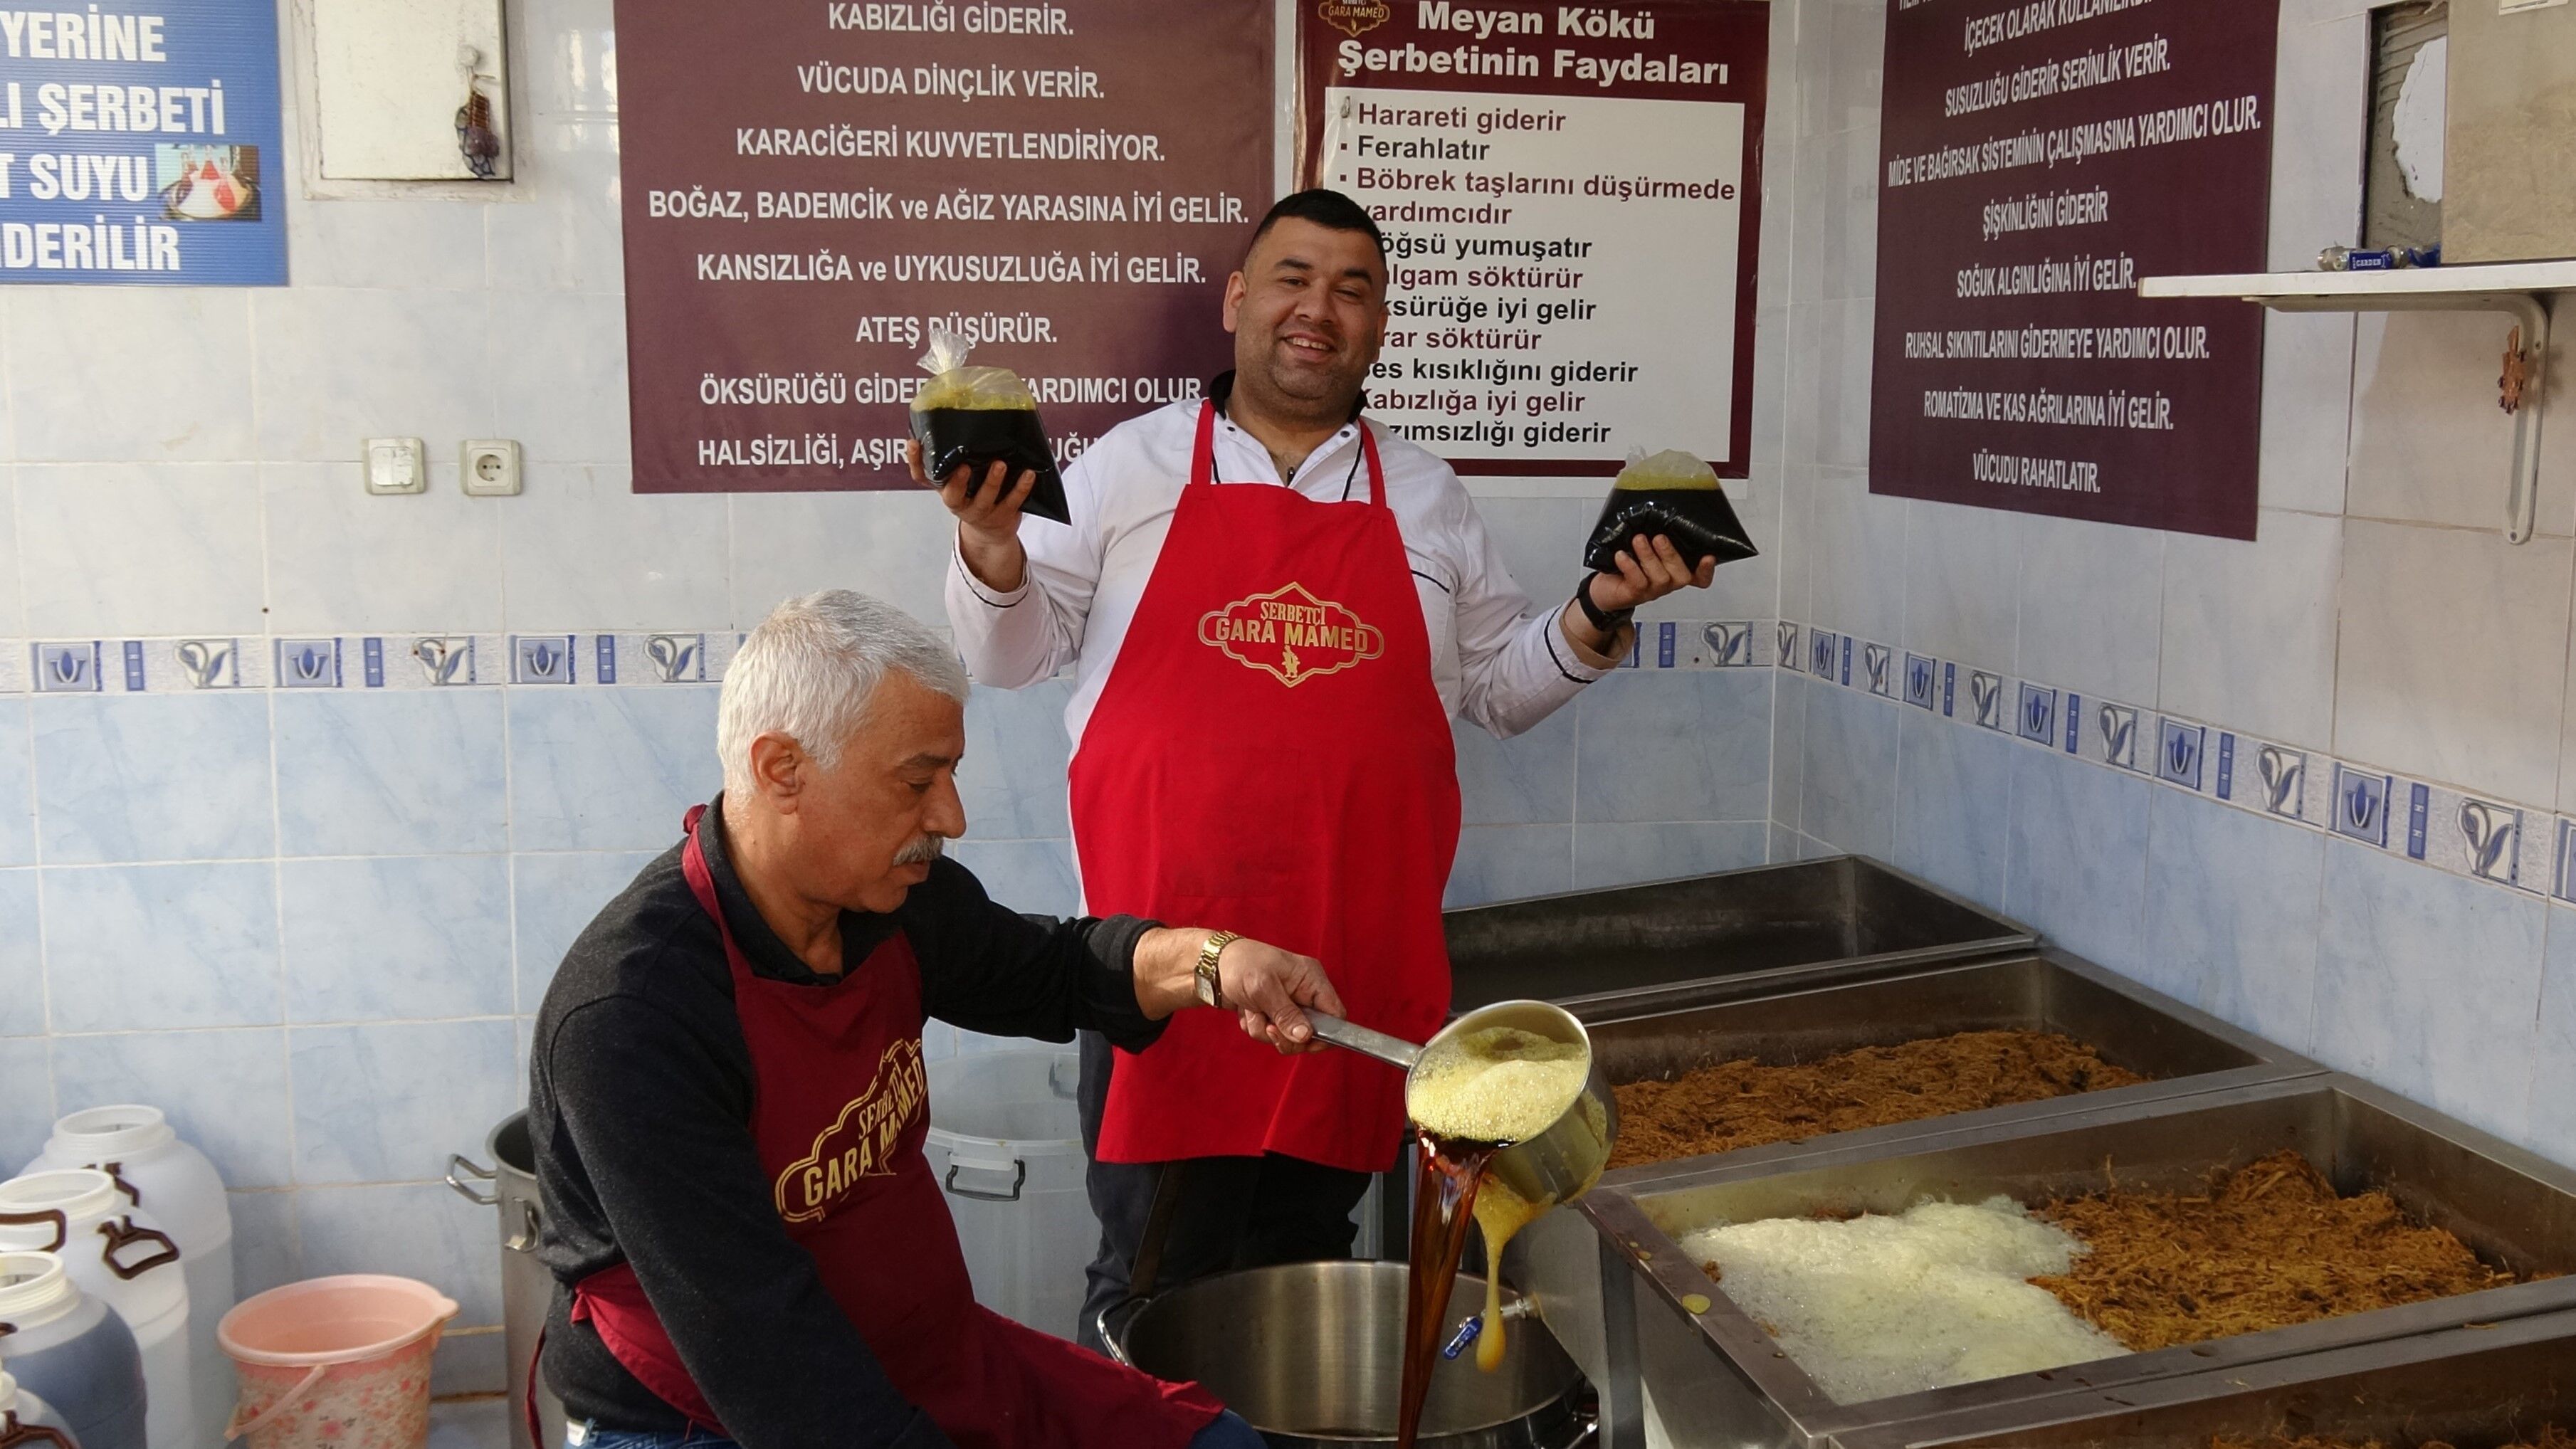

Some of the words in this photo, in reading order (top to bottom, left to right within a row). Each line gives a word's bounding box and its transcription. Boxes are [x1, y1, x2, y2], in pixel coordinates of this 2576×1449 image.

[829, 0, 955, 31] KABIZLIĞI
[964, 1, 1073, 34] GİDERİR.
[1328, 5, 1350, 16] GARA
[1353, 6, 1385, 18] MAMED
[1419, 1, 1542, 39] Meyan
[1558, 7, 1654, 38] Kökü
[1964, 17, 2004, 57] İÇECEK
[2007, 0, 2056, 38] OLARAK
[0, 4, 167, 62] YERİNE
[798, 60, 908, 94] VÜCUDA
[915, 63, 1016, 102] DİNÇLİK
[1023, 66, 1104, 98] VERİR.
[1338, 40, 1538, 77] Şerbetinin
[1554, 49, 1728, 87] Faydaları
[1945, 72, 2009, 117] SUSUZLUĞU
[2012, 58, 2059, 102] GİDERİR
[2061, 44, 2122, 91] SERİNLİK
[2125, 33, 2170, 78] VERİR.
[38, 80, 225, 135] ŞERBETİ
[1360, 103, 1466, 127] Harareti
[1478, 108, 1566, 134] giderir
[737, 124, 897, 157] KARACİĞERİ
[907, 128, 1165, 161] KUVVETLENDİRİYOR.
[1359, 135, 1490, 160] Ferahlatır
[1888, 154, 1911, 186] MİDE
[1914, 155, 1925, 183] VE
[1928, 145, 1980, 181] BAĞIRSAK
[1982, 127, 2044, 172] SİSTEMİNİN
[2047, 117, 2135, 169] ÇALIŞMASINA
[2138, 104, 2208, 147] YARDIMCI
[2212, 95, 2260, 135] OLUR.
[29, 154, 149, 201] SUYU
[1358, 168, 1455, 191] Böbrek
[1466, 172, 1573, 198] taşlarını
[1584, 175, 1734, 201] düşürmede
[650, 185, 748, 222] BOĞAZ,
[757, 187, 893, 218] BADEMCİK
[900, 200, 927, 219] ve
[935, 188, 994, 220] AĞIZ
[1001, 195, 1127, 221] YARASINA
[1134, 191, 1161, 221] İYİ
[1170, 192, 1248, 223] GELİR.
[2056, 185, 2108, 226] GİDERİR
[0, 215, 180, 270] DERİLİR
[1380, 231, 1445, 259] öğsü
[1456, 238, 1592, 262] yumuşatır
[698, 249, 853, 280] KANSIZLIĞA
[858, 262, 886, 280] ve
[895, 251, 1084, 282] UYKUSUZLUĞA
[1091, 251, 1118, 282] İYİ
[1127, 253, 1205, 283] GELİR.
[1387, 264, 1457, 293] lgam
[1468, 266, 1583, 288] söktürür
[1957, 263, 1995, 297] SOĞUK
[1997, 258, 2071, 295] ALGINLIĞINA
[2074, 254, 2090, 291] İYİ
[2093, 252, 2136, 290] GELİR.
[1384, 296, 1488, 322] sürüğe
[1498, 297, 1526, 324] iyi
[1537, 299, 1596, 325] gelir
[856, 316, 920, 349] ATEŞ
[928, 312, 1057, 349] DÜŞÜRÜR.
[1382, 328, 1417, 347] rar
[1426, 328, 1541, 349] söktürür
[1905, 332, 1944, 358] RUHSAL
[1947, 330, 2018, 358] SIKINTILARINI
[2021, 323, 2093, 358] GİDERMEYE
[2096, 327, 2160, 359] YARDIMCI
[2164, 327, 2209, 359] OLUR.
[700, 372, 846, 404] ÖKSÜRÜĞÜ
[1021, 376, 1127, 404] ARDIMCI
[1366, 360, 1402, 379] es
[1414, 359, 1540, 385] kısıklığını
[1551, 361, 1638, 386] giderir
[1488, 390, 1515, 416] iyi
[1527, 391, 1585, 416] gelir
[1924, 386, 1984, 419] ROMATİZMA
[1987, 393, 2001, 420] VE
[2004, 394, 2026, 421] KAS
[2028, 388, 2106, 426] AĞRILARINA
[2108, 390, 2125, 427] İYİ
[2128, 391, 2173, 429] GELİR.
[1390, 420, 1514, 446] zımsızlığı
[1524, 422, 1611, 447] giderir
[699, 433, 843, 468] HALSİZLİĞİ,
[852, 439, 908, 472] AŞIR
[1973, 448, 2019, 484] VÜCUDU
[2022, 458, 2100, 492] RAHATLATIR.
[1261, 601, 1326, 626] ŞERBETÇİ
[1216, 617, 1276, 643] GARA
[1284, 623, 1368, 652] MAMED
[803, 1136, 873, 1206] GARA
